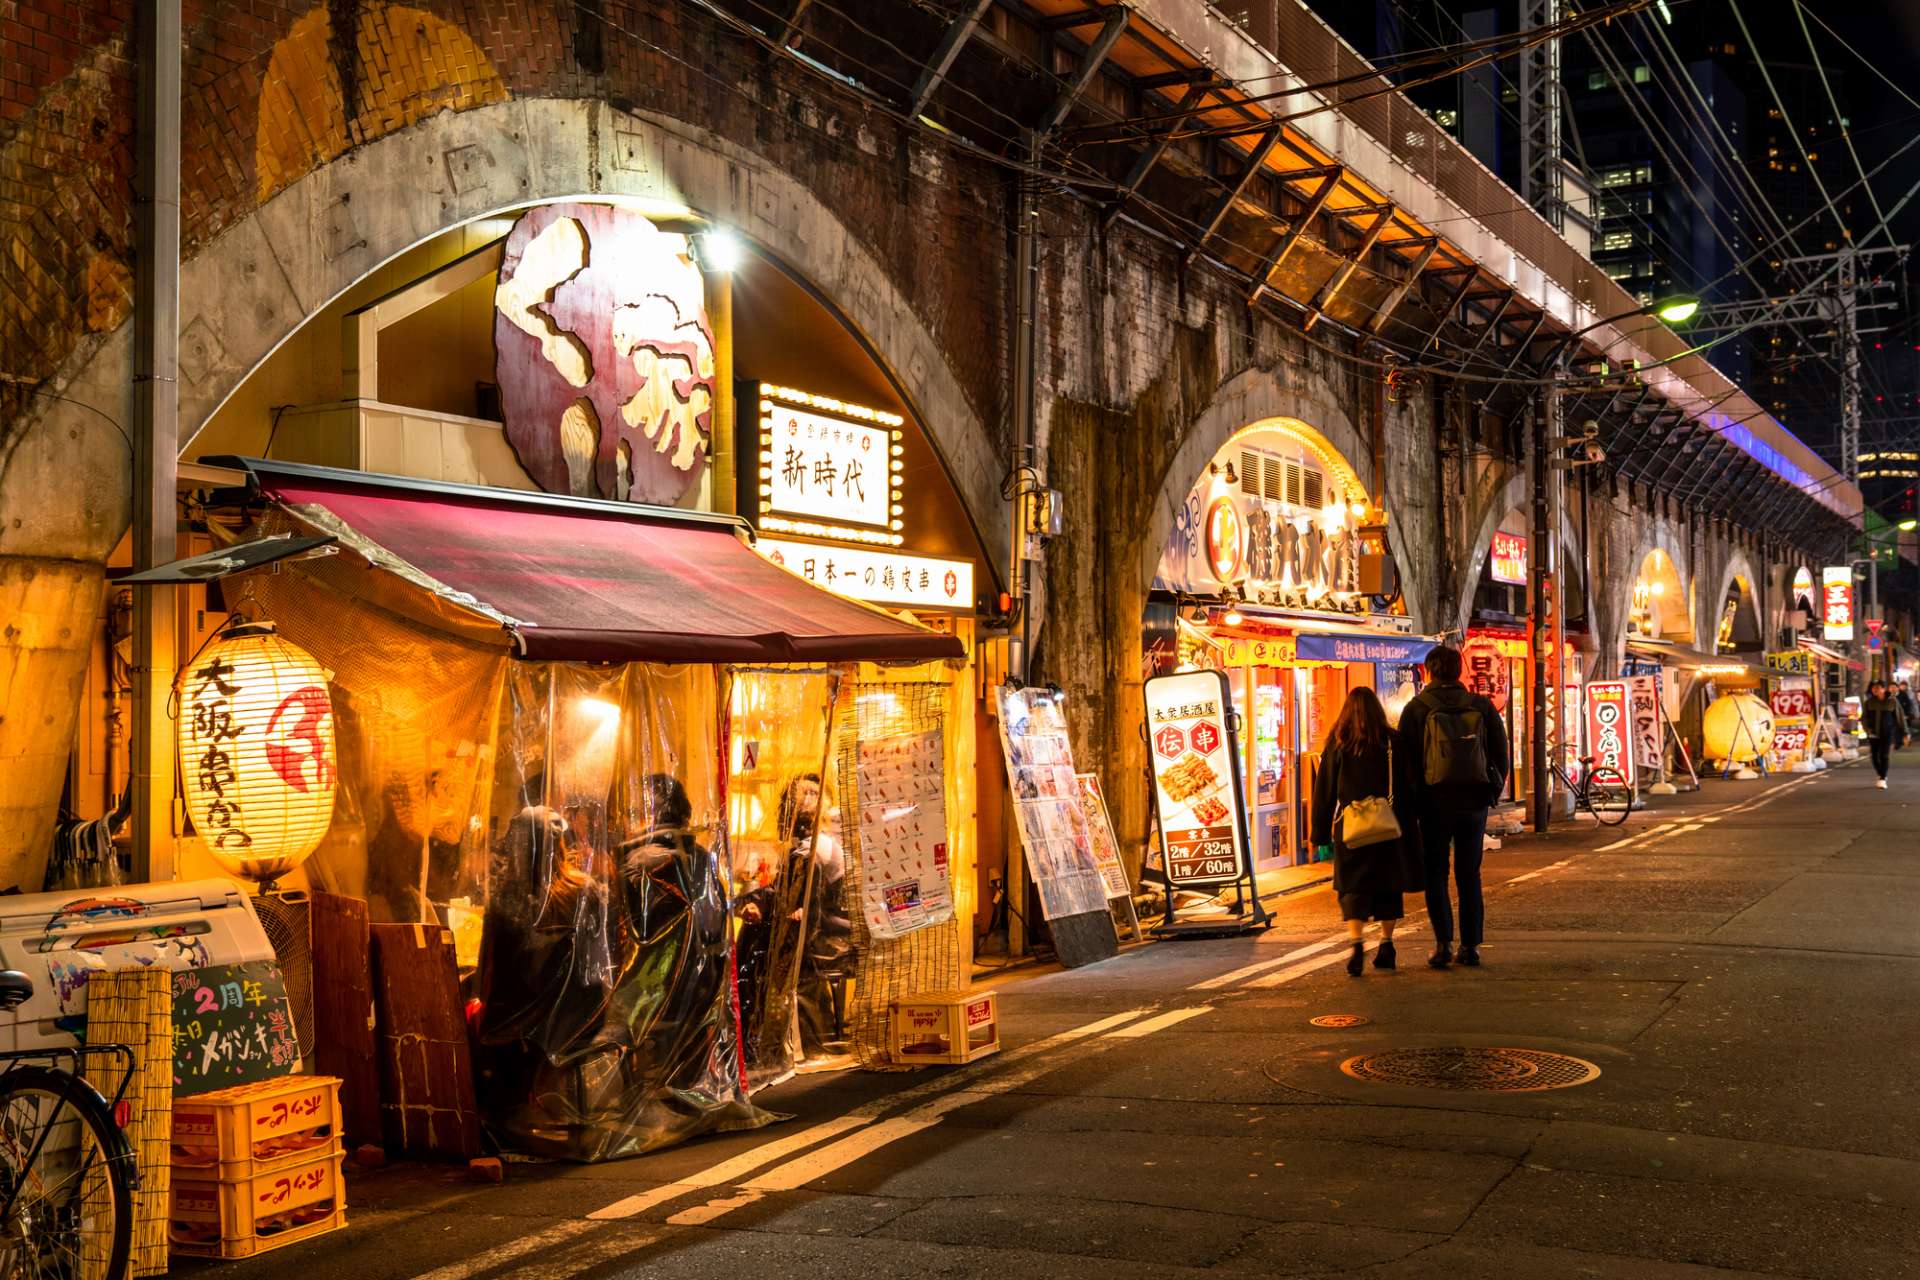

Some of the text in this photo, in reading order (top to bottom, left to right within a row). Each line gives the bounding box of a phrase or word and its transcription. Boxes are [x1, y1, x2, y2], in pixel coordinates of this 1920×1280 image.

[782, 443, 864, 503] 新時代
[803, 557, 929, 593] 日本一の鶏皮串
[1827, 585, 1850, 624] 王将
[1155, 702, 1215, 720] 大衆居酒屋
[191, 656, 252, 849] 大阪串かつ
[194, 980, 267, 1014] 2周年
[256, 1095, 321, 1128] ホッピー
[259, 1168, 324, 1204] ホッピー
